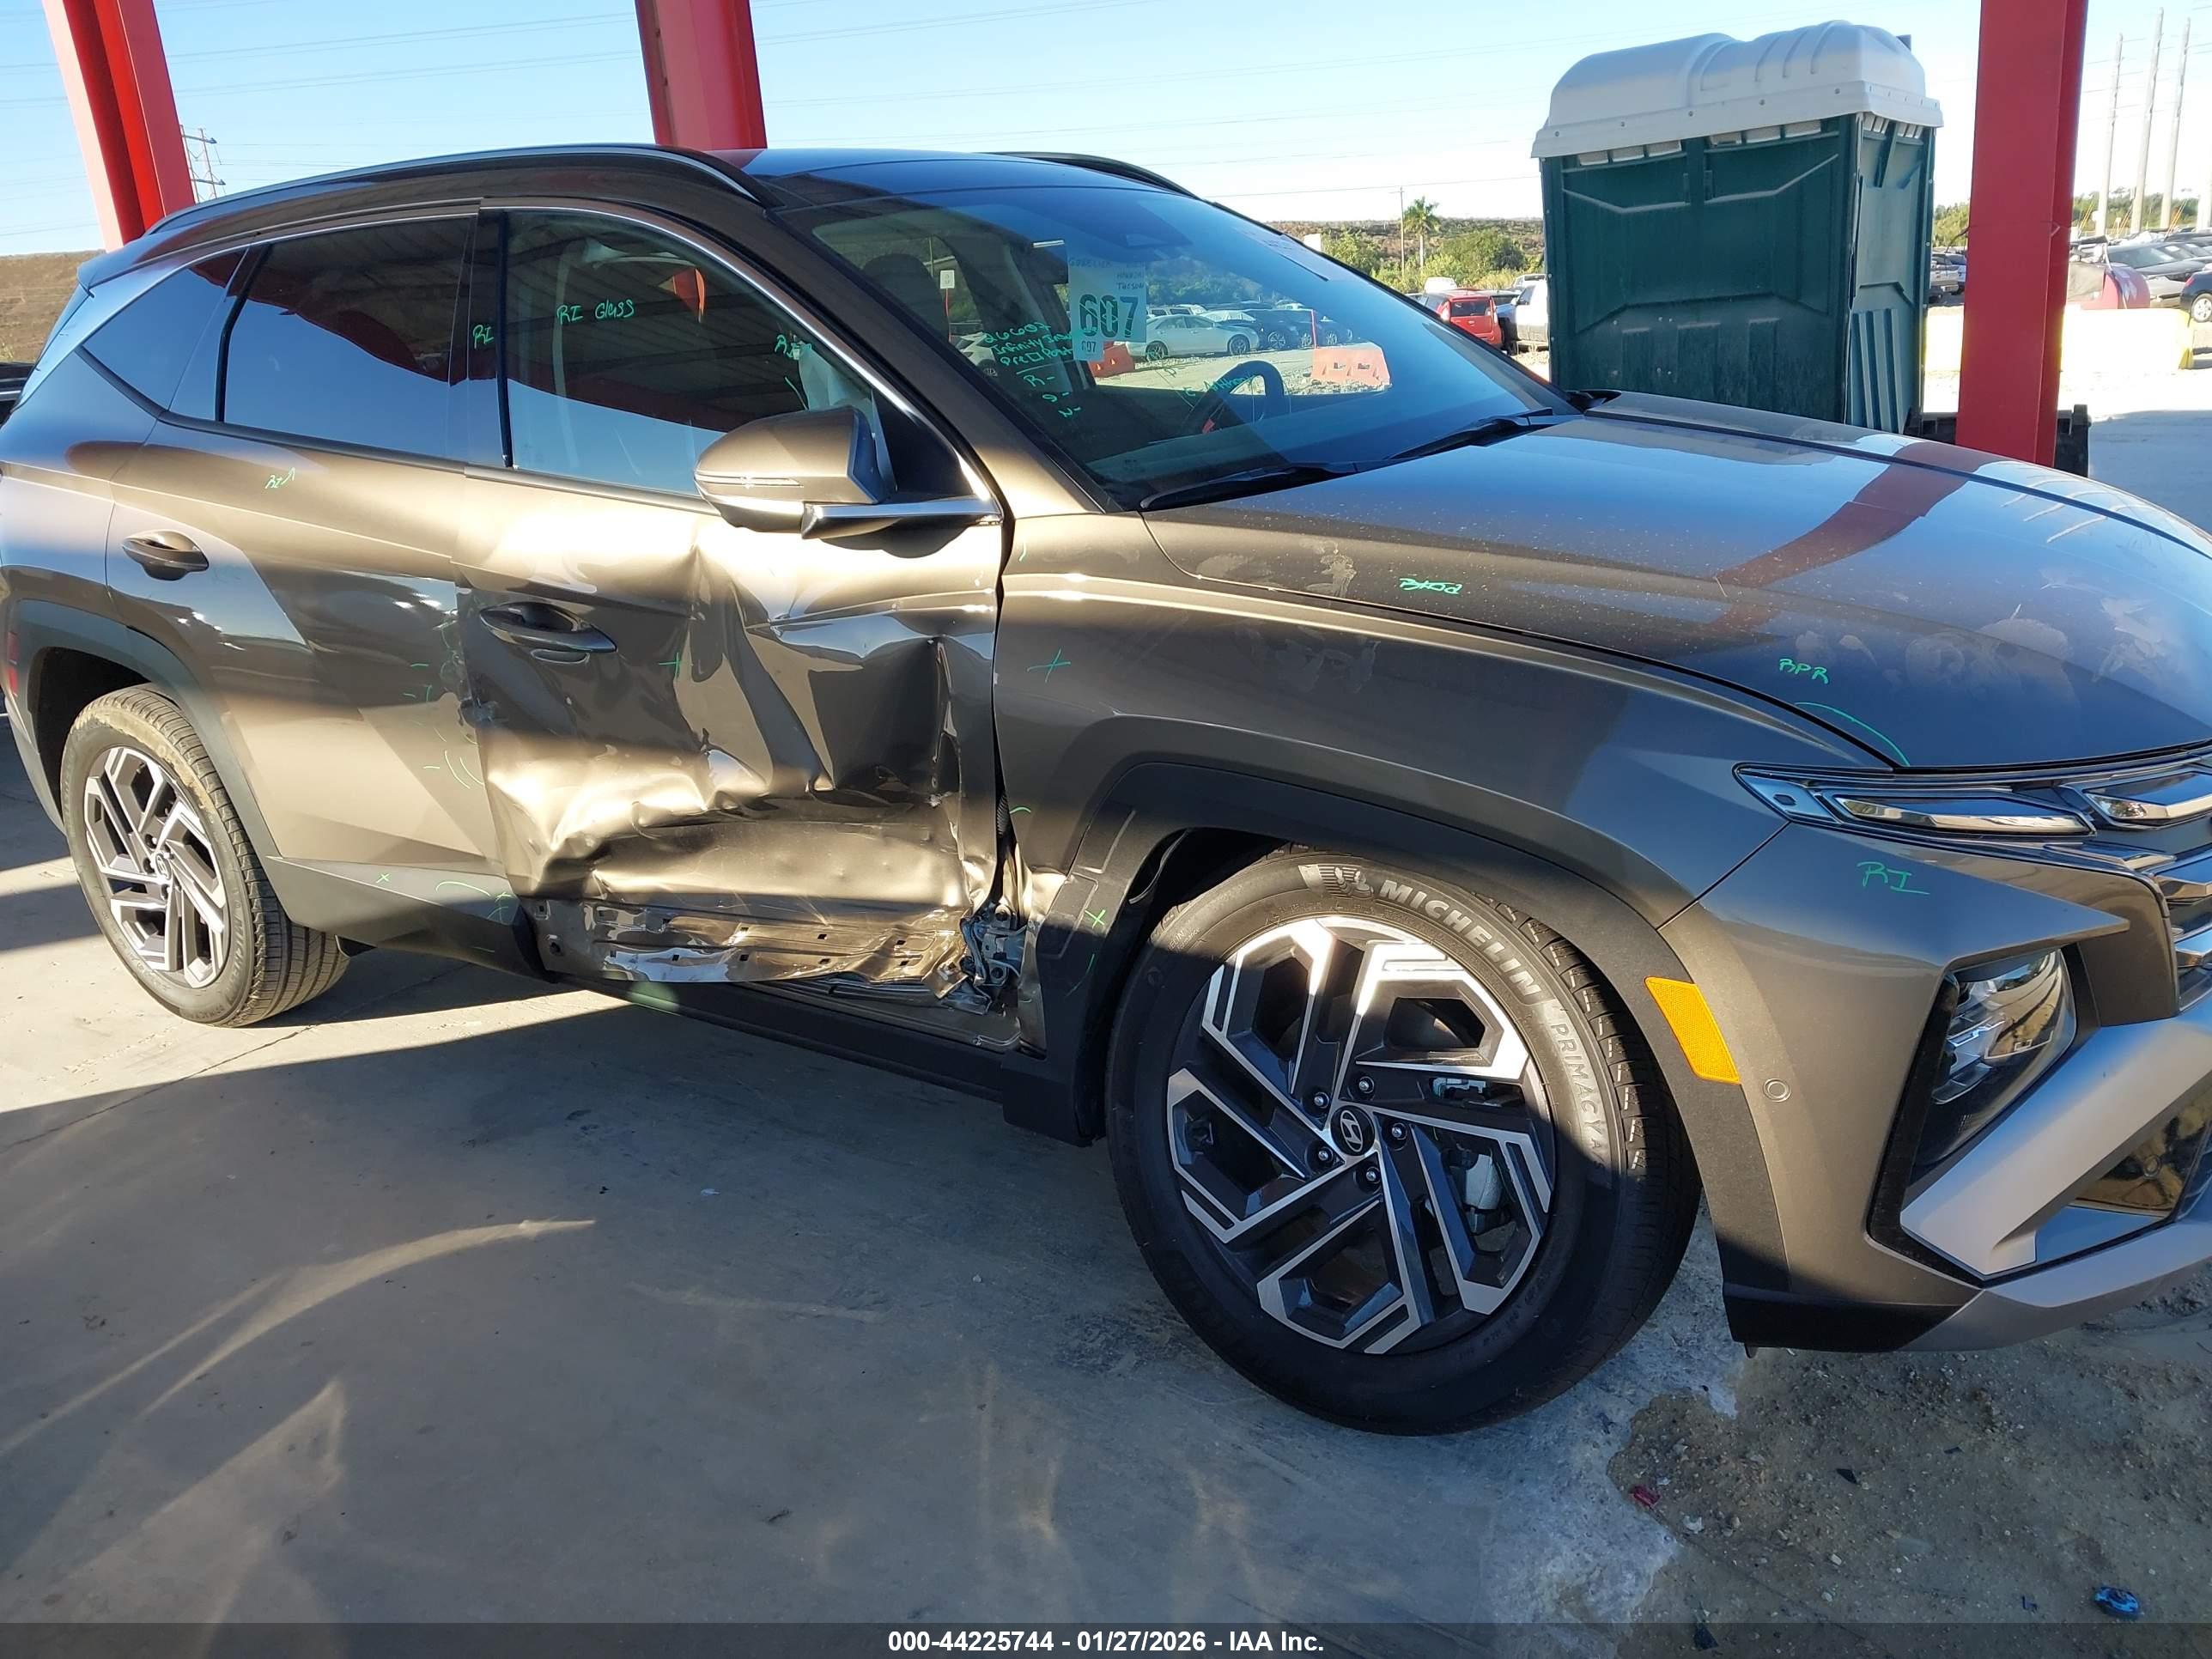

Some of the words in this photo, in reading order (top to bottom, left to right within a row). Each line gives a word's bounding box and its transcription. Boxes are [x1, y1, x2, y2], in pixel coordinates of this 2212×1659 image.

[557, 304, 584, 325] RI
[1079, 294, 1139, 338] 607
[472, 324, 495, 349] RI
[1856, 861, 1930, 895] RI
[1379, 879, 1542, 997] MICHELIN
[1551, 1023, 1603, 1135] PRIMACY
